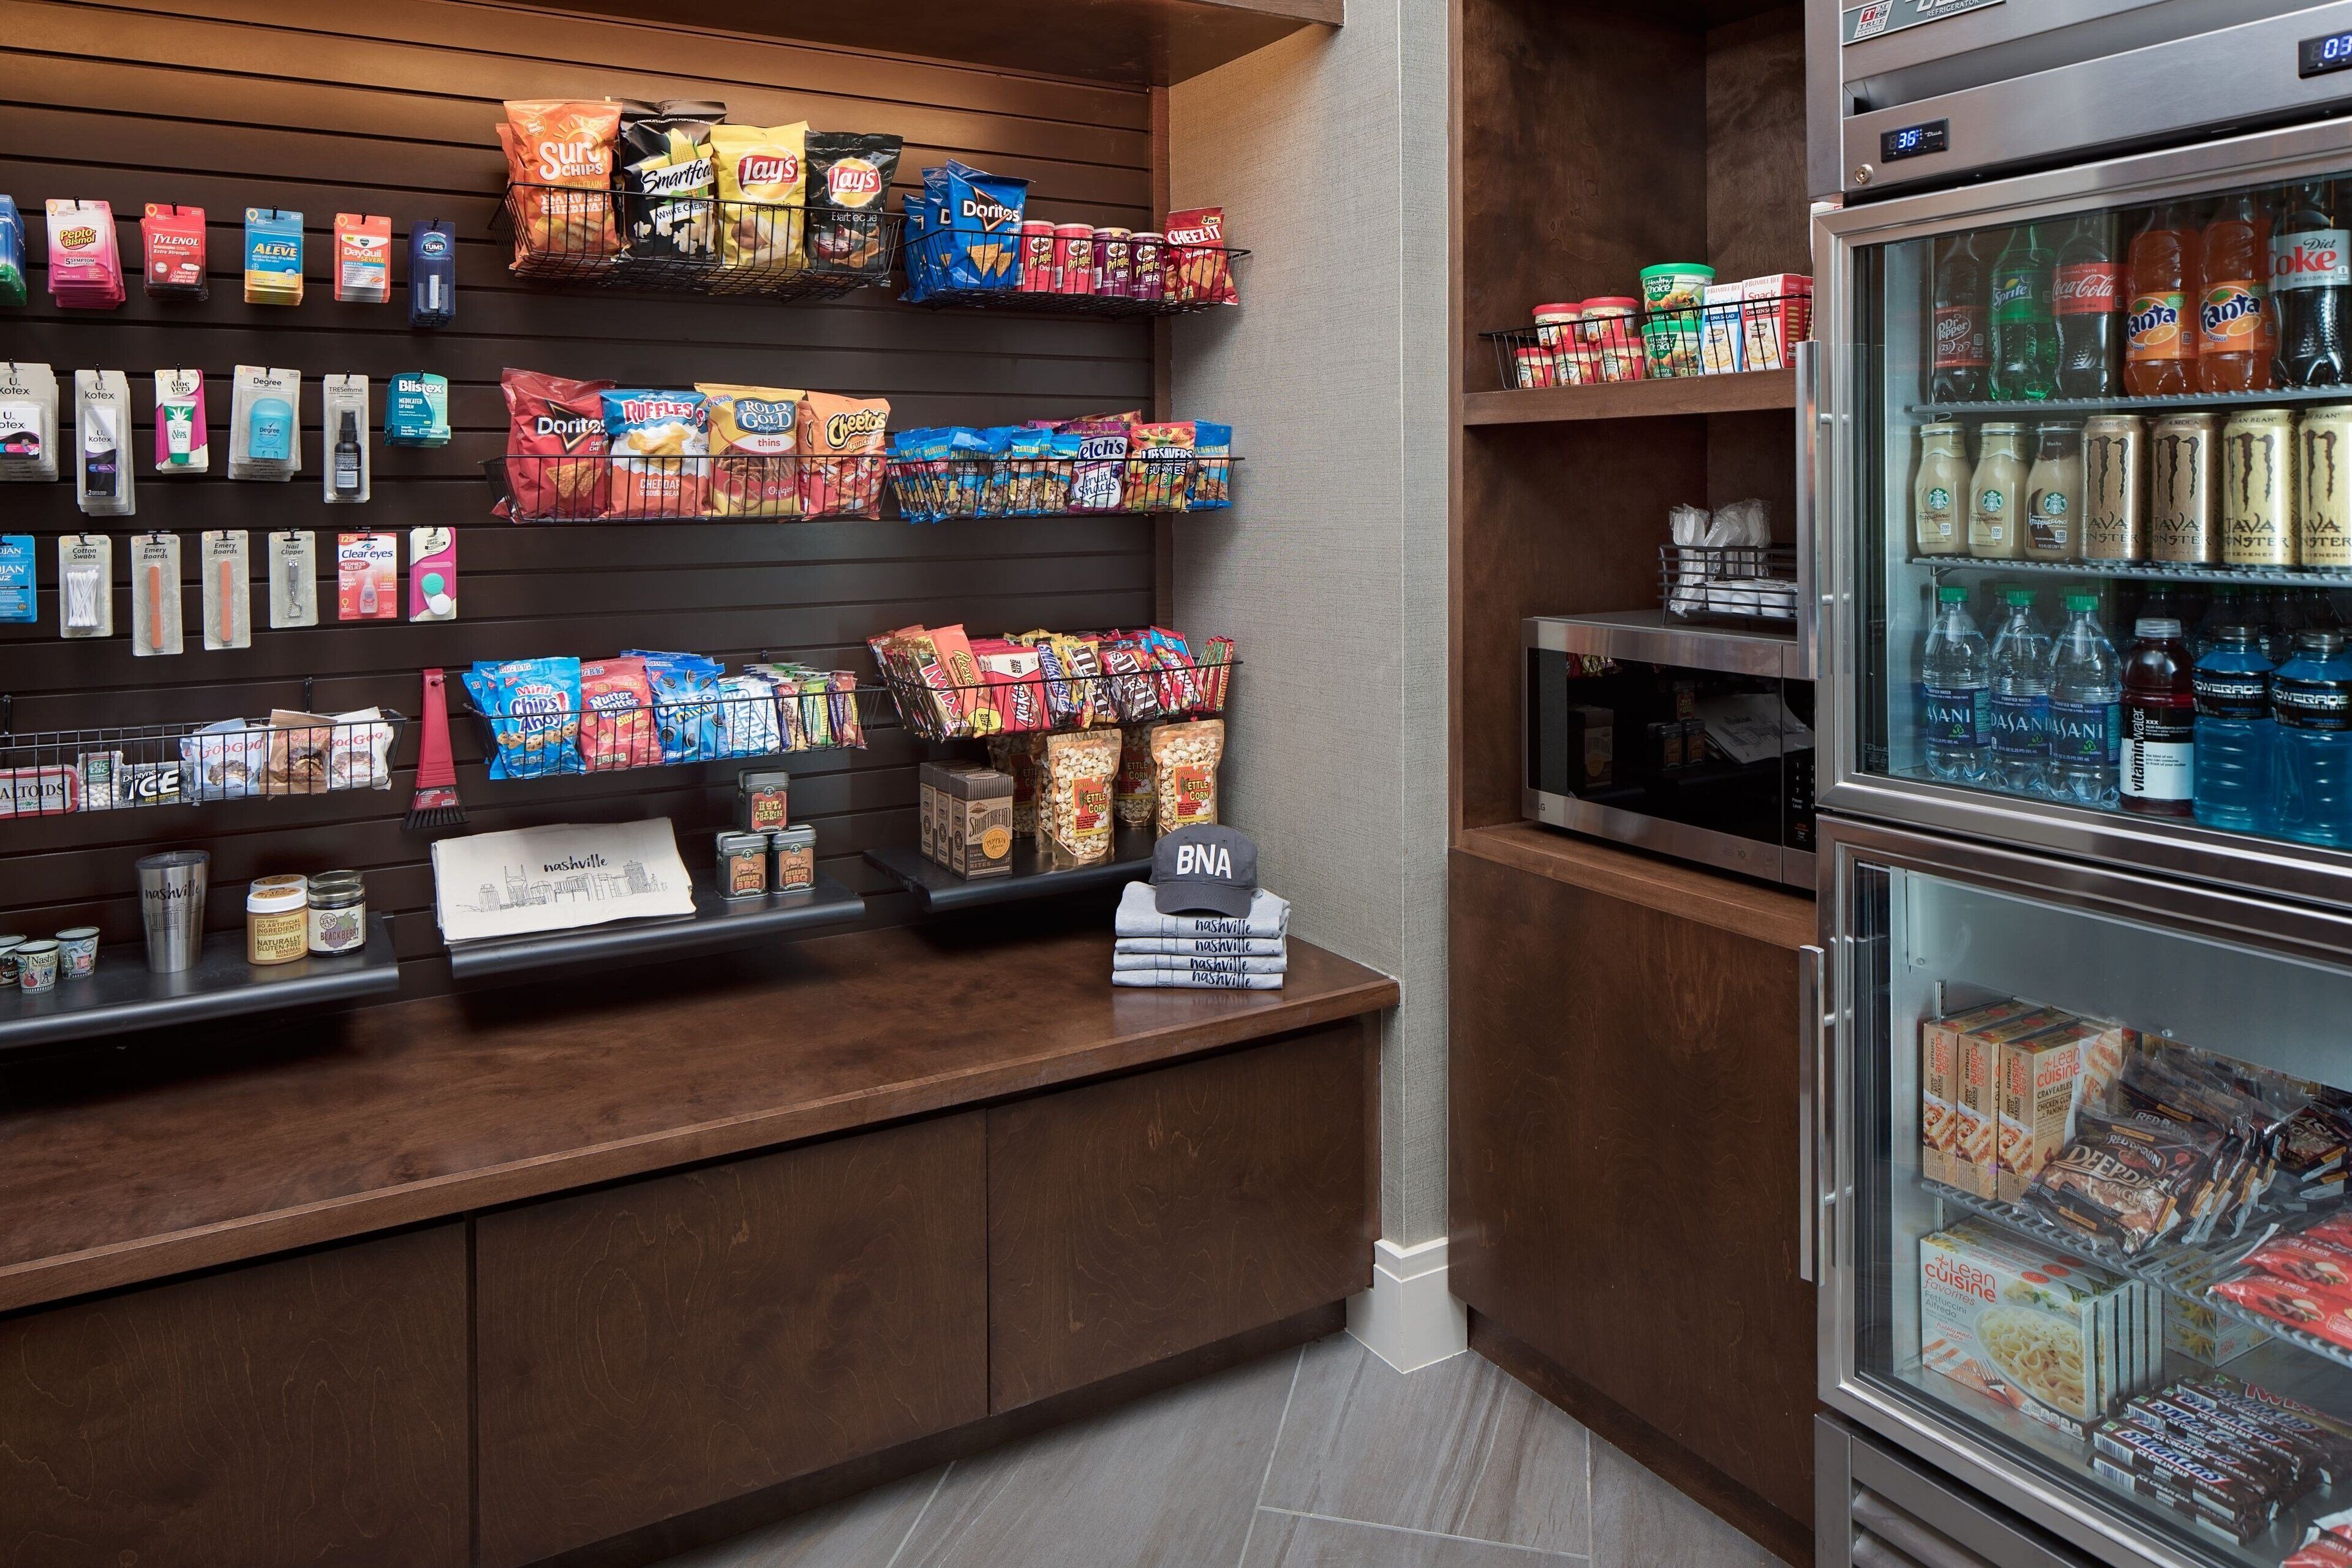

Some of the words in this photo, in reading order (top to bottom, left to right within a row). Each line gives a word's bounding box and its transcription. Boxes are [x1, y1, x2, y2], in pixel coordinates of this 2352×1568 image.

[1927, 0, 1980, 17] REFRIGERATOR
[1859, 18, 1885, 29] TRUE
[1898, 130, 1916, 148] 36
[539, 141, 601, 180] Sun
[561, 164, 604, 176] CHIPS
[742, 154, 797, 186] Lay's
[832, 167, 876, 194] Lay's
[963, 200, 1020, 222] Doritos
[60, 228, 96, 241] Pepto-
[65, 233, 96, 247] Bismol
[153, 233, 200, 246] TYLENOL
[252, 243, 298, 256] ALEVE
[344, 247, 382, 258] DayQuil
[2304, 238, 2337, 250] Diet
[2268, 246, 2337, 277] Coke
[1646, 284, 1672, 294] Choice
[1648, 276, 1672, 286] Healthy
[1749, 279, 1770, 287] BUMBLE
[2053, 274, 2117, 301] Coca-Cola
[1994, 283, 2028, 306] Sprite
[2201, 294, 2261, 334] Fanta
[1937, 322, 1969, 341] Pepper
[1944, 317, 1959, 330] Dr
[253, 377, 282, 386] Degree
[399, 380, 443, 396] Blistex
[624, 401, 694, 424] RUFFLES
[745, 401, 788, 412] ROLD
[742, 412, 793, 429] GOLD
[827, 409, 888, 448] Cheetos
[758, 439, 781, 447] thins
[1079, 480, 1116, 499] Snacks
[2154, 513, 2200, 532] JAVA
[2226, 513, 2276, 533] JAVA
[370, 551, 393, 560] eyes
[515, 663, 531, 672] BAG
[589, 666, 604, 675] BAG
[517, 685, 550, 696] Mini
[921, 658, 962, 718] TWIX
[590, 691, 632, 709] Nutter
[2274, 690, 2348, 705] POWERADE
[511, 697, 557, 716] Chips
[676, 704, 713, 724] mini
[616, 711, 643, 727] Bites
[1991, 712, 2049, 733] DASANI
[2132, 707, 2144, 792] vitaminwater
[123, 769, 157, 783] Dentyne
[129, 769, 182, 799] ICE
[1189, 791, 1208, 801] CORN
[755, 810, 783, 821] CHICKEN
[1088, 802, 1106, 813] CORN
[969, 807, 1011, 837] SHORTBREAD
[986, 837, 1006, 846] PUMPKIN
[544, 854, 608, 872] nashville
[1177, 843, 1232, 879] BNA
[145, 880, 202, 901] nashville
[257, 924, 300, 933] INGREDIENTS
[267, 919, 300, 927] ARTIFICIAL
[1196, 917, 1251, 935] nashville
[257, 935, 301, 946] NATURALLY
[320, 927, 359, 941] BLACKBERRY
[257, 941, 301, 951] GLUTEN-FREE
[276, 946, 301, 955] MINIMAL
[2052, 1047, 2081, 1069] Lean
[2037, 1063, 2081, 1088] cuisine
[2037, 1080, 2073, 1099] CRAVEABLES
[2037, 1098, 2059, 1112] CHICKEN
[2046, 1107, 2064, 1117] PANINI
[2108, 1134, 2129, 1145] RED
[2130, 1141, 2162, 1169] BARON
[2065, 1145, 2127, 1178] DEEP
[1923, 1279, 1975, 1306] favorites
[1925, 1290, 1967, 1315] Fettuccini
[1925, 1299, 1957, 1319] Alfredo
[1935, 1321, 1956, 1336] freshly
[1956, 1329, 1973, 1340] made
[1945, 1331, 1964, 1342] pasta
[2135, 1447, 2147, 1458] ICE
[2148, 1454, 2174, 1472] CREAM
[2173, 1466, 2190, 1479] BAR
